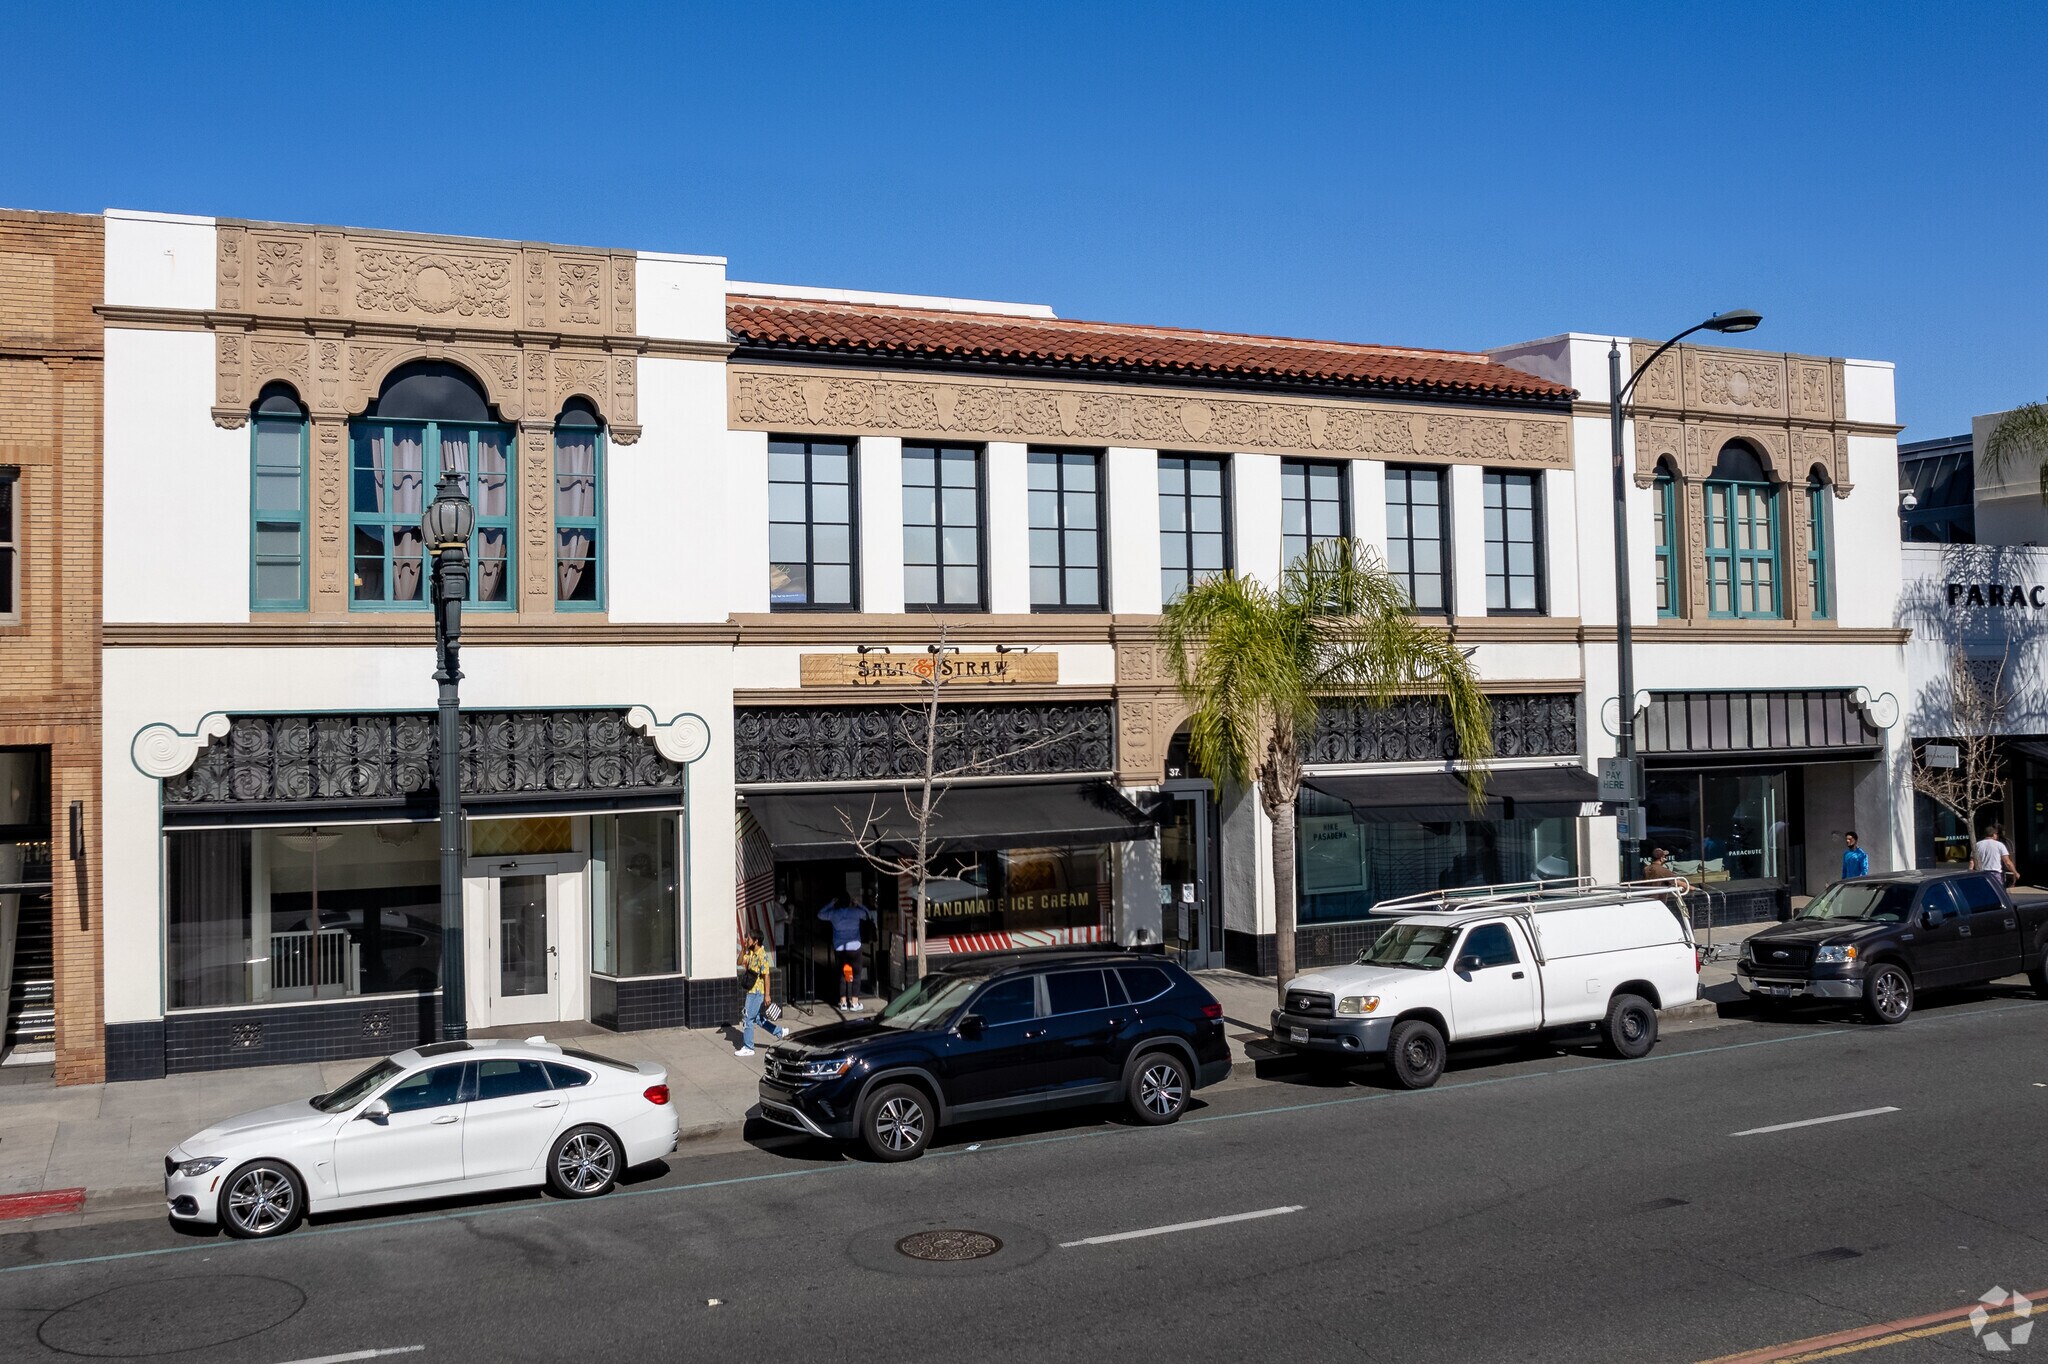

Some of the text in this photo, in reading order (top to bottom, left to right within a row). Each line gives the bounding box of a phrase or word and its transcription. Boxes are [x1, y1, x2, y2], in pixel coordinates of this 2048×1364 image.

[1948, 584, 2046, 610] PARAC
[858, 658, 1008, 678] SALT & STRAW
[1606, 771, 1621, 780] PAY
[1604, 781, 1624, 789] HERE
[1579, 801, 1603, 817] NIKE
[1322, 823, 1339, 831] NIKE
[1312, 831, 1348, 841] PASADENA
[925, 892, 1090, 918] HANDMADE ICE CREAM
